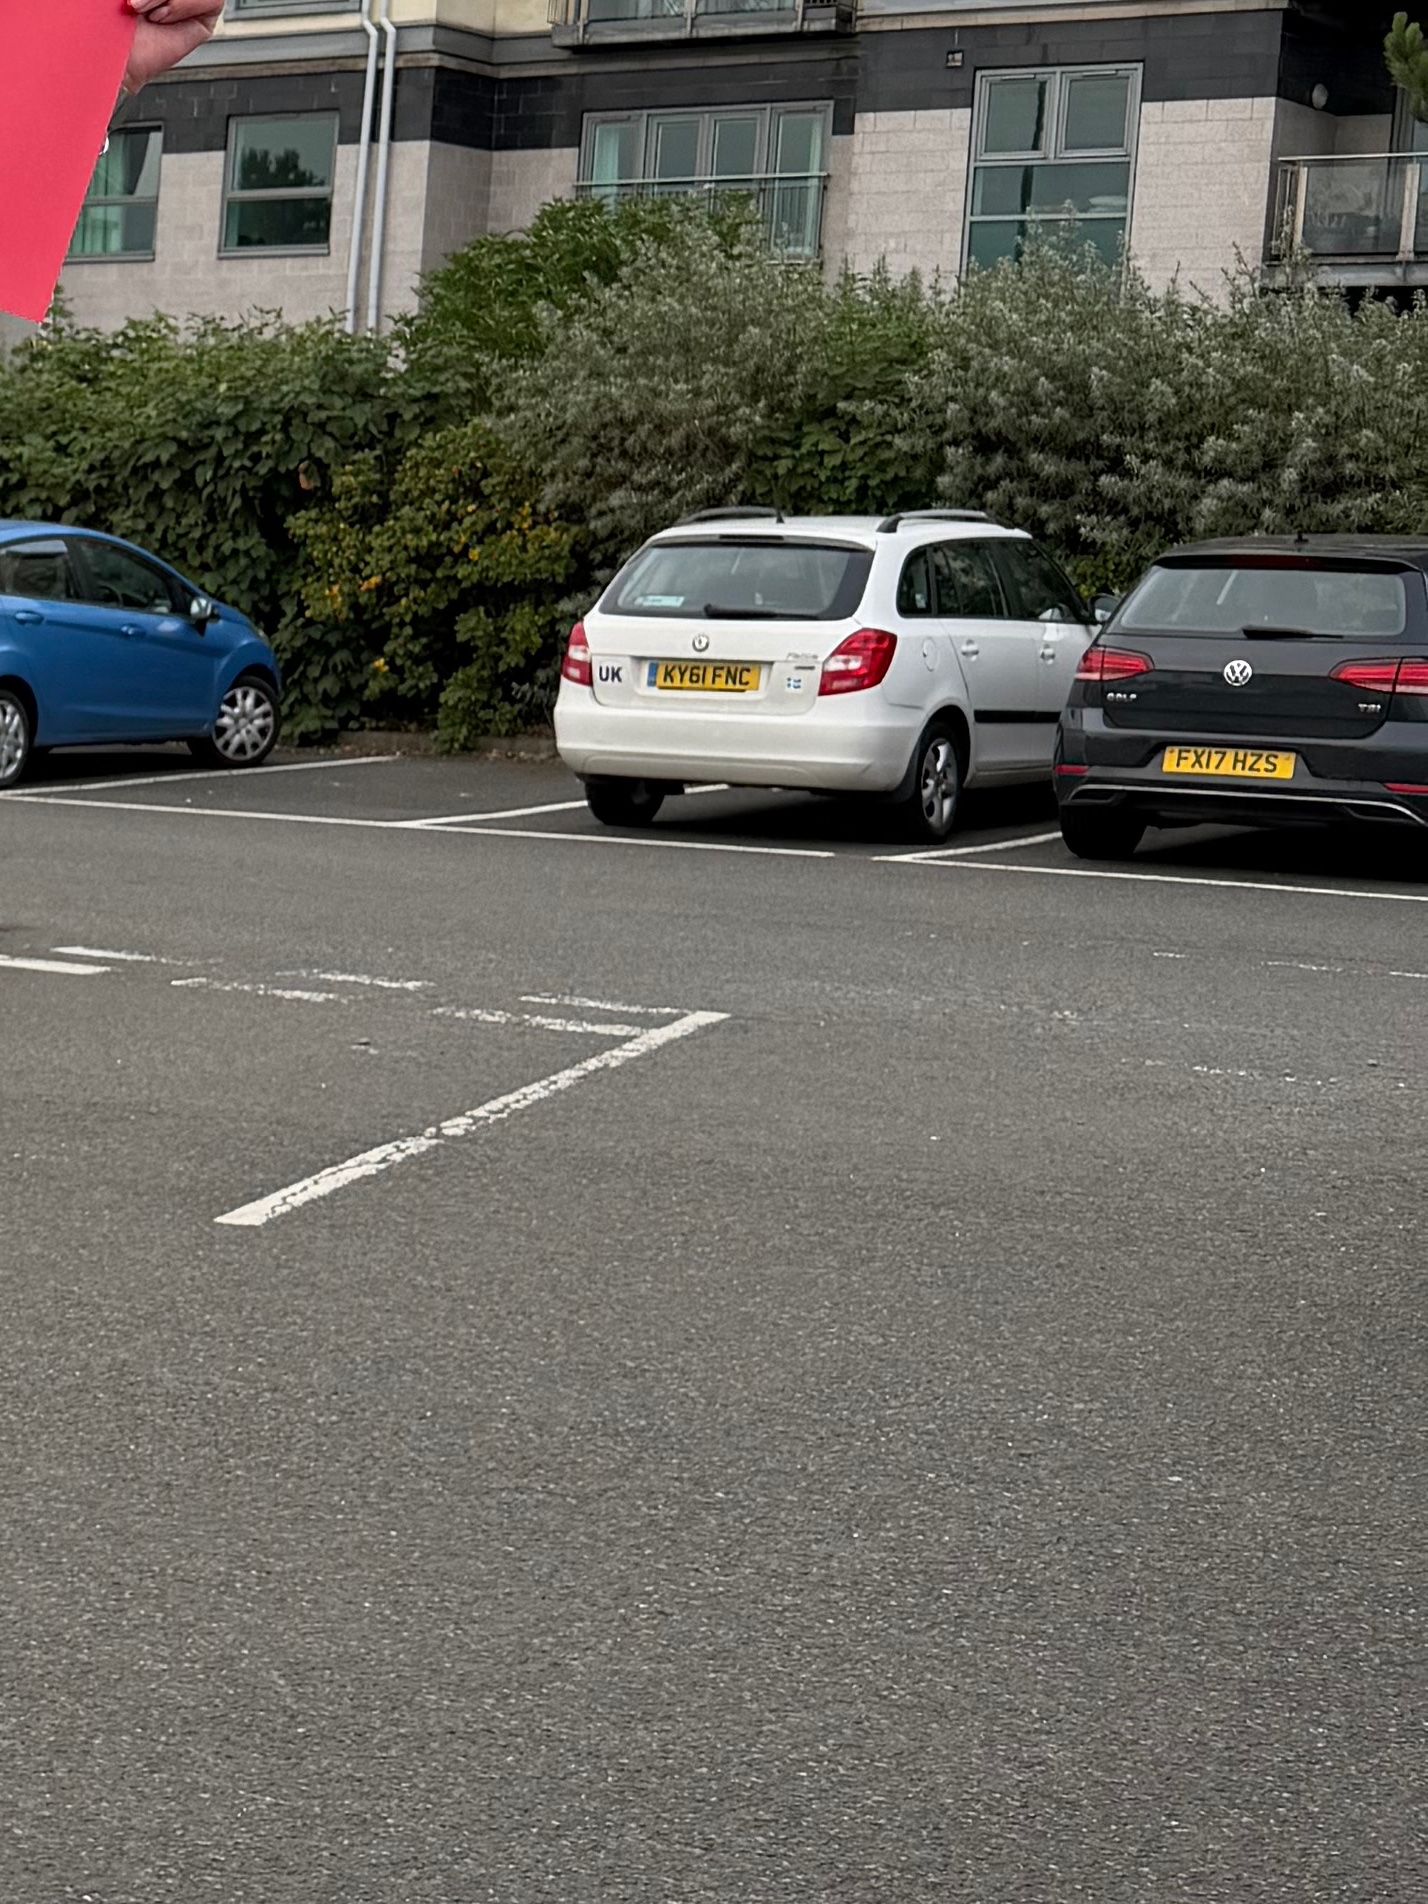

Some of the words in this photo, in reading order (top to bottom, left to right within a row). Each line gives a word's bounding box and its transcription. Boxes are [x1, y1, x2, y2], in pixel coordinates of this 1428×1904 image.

[598, 666, 623, 683] UK
[662, 664, 707, 685] KY61
[711, 666, 751, 686] FNC
[1175, 747, 1225, 770] FX17
[1232, 751, 1279, 774] HZS
